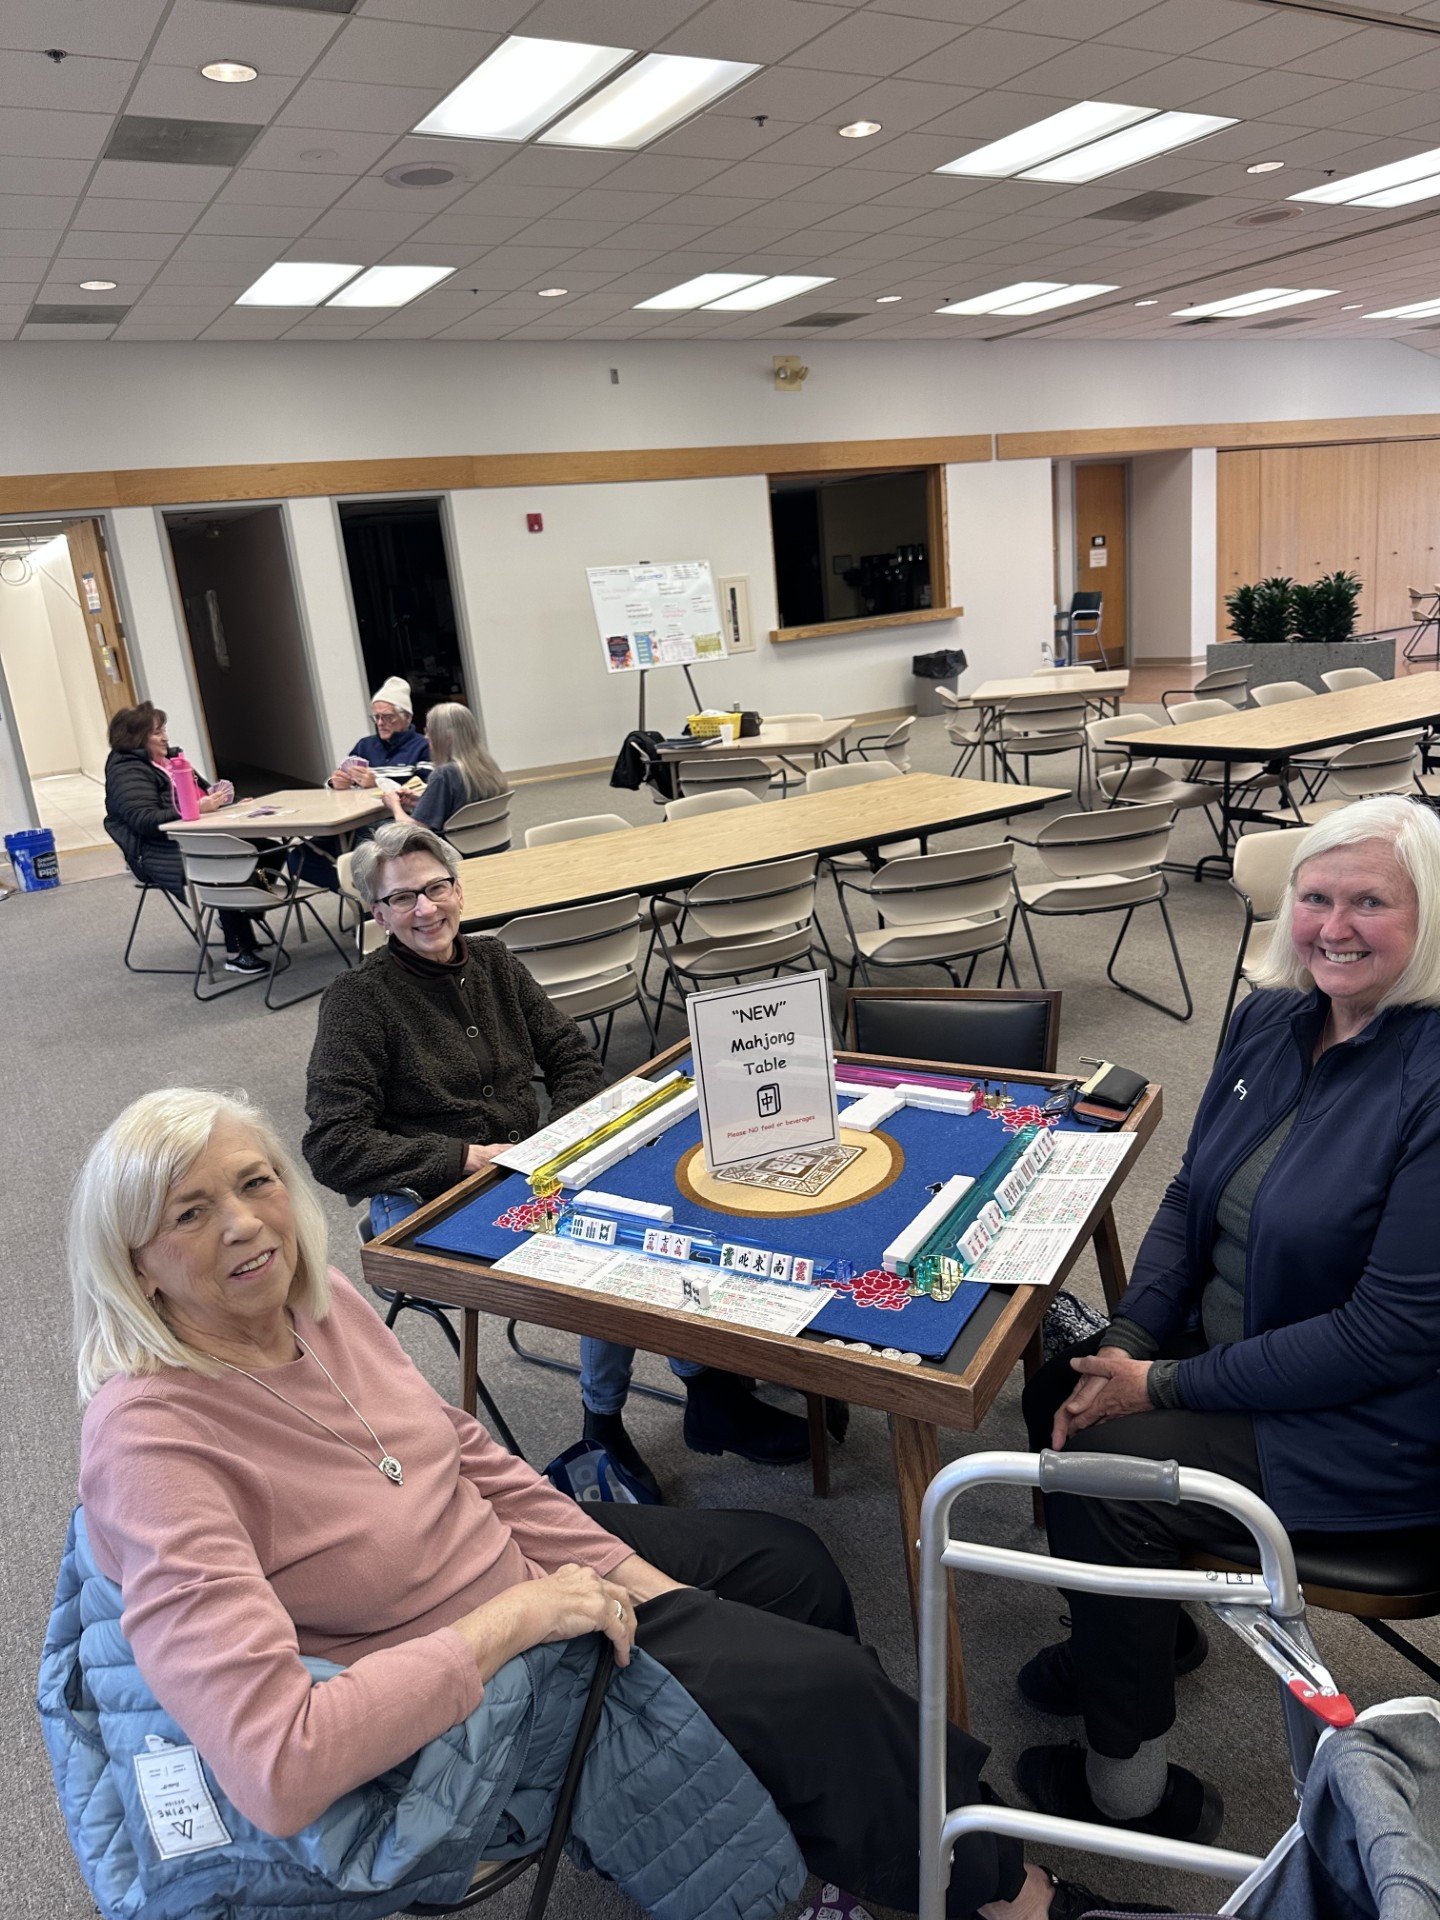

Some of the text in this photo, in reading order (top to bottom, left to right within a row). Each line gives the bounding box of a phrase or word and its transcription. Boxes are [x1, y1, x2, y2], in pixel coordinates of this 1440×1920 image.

[731, 1031, 795, 1053] Mahjong
[744, 1057, 787, 1076] Table
[727, 1130, 746, 1138] Please
[748, 1126, 759, 1134] NO
[761, 1122, 775, 1131] food
[785, 1115, 815, 1125] beverages
[158, 1803, 199, 1818] ALPINE
